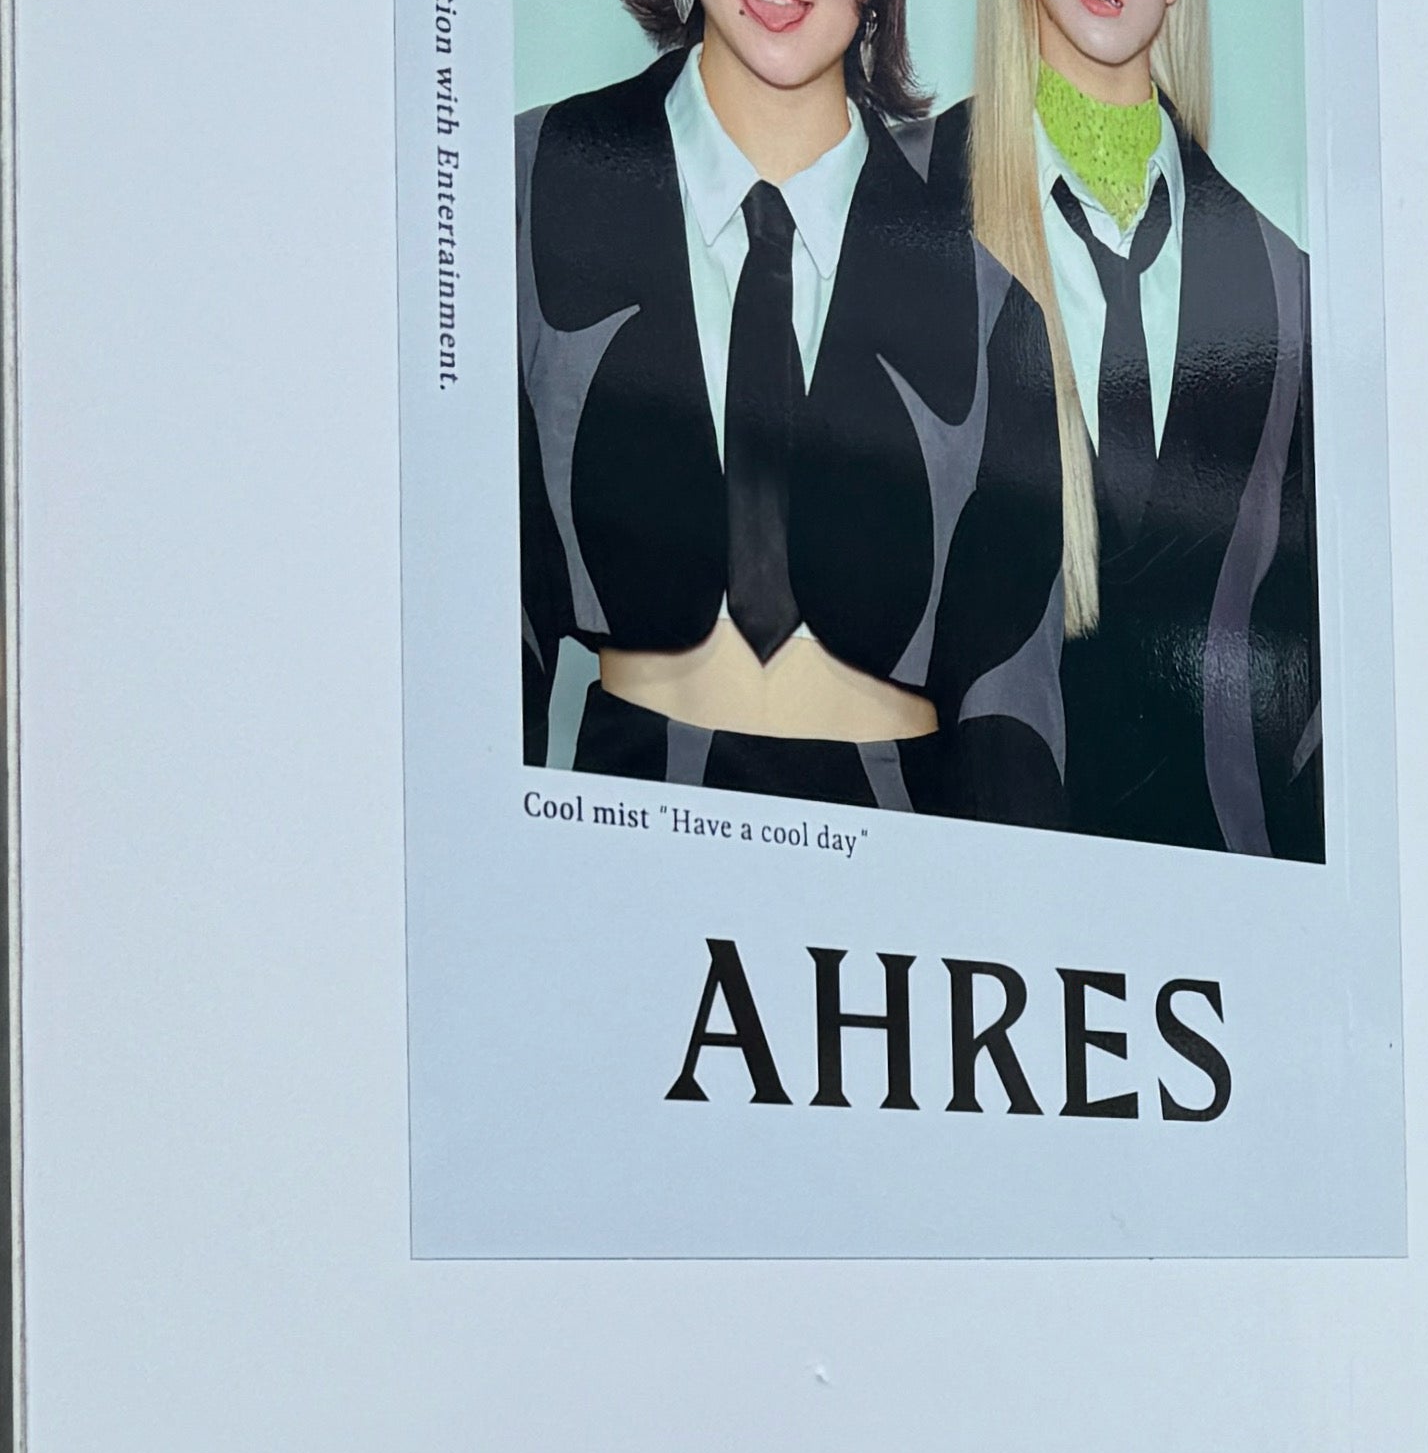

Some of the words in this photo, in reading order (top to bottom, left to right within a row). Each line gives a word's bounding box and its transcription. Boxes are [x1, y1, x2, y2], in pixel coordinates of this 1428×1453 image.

[437, 66, 460, 135] with
[438, 145, 461, 391] Entertainment.
[523, 791, 584, 822] Cool
[593, 802, 650, 829] mist
[660, 805, 732, 838] "Have
[740, 822, 753, 840] a
[761, 822, 809, 846] cool
[817, 824, 869, 858] day"
[664, 937, 1232, 1123] AHRES
